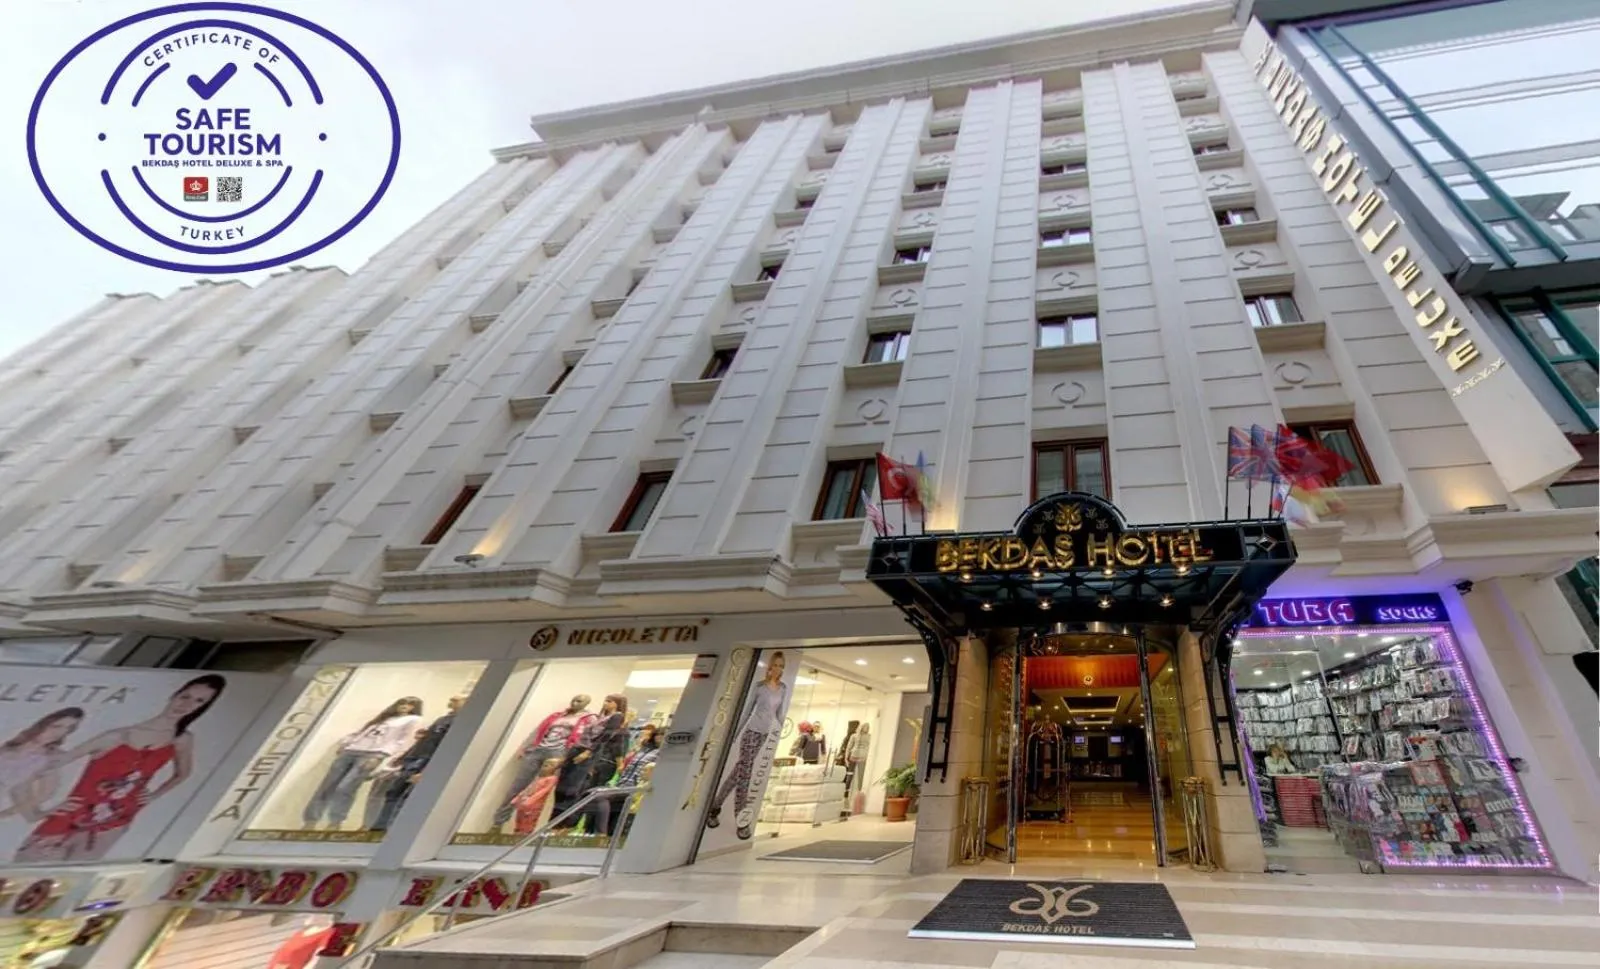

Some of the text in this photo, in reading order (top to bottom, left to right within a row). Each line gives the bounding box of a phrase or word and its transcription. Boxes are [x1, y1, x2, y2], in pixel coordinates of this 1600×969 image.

[1312, 133, 1398, 253] HOTEL
[1382, 246, 1481, 372] DELUXE
[1086, 528, 1213, 567] HOTEL
[1258, 599, 1355, 625] TUBA
[567, 625, 701, 645] NICOLETTA
[1054, 925, 1095, 935] HOTEL
